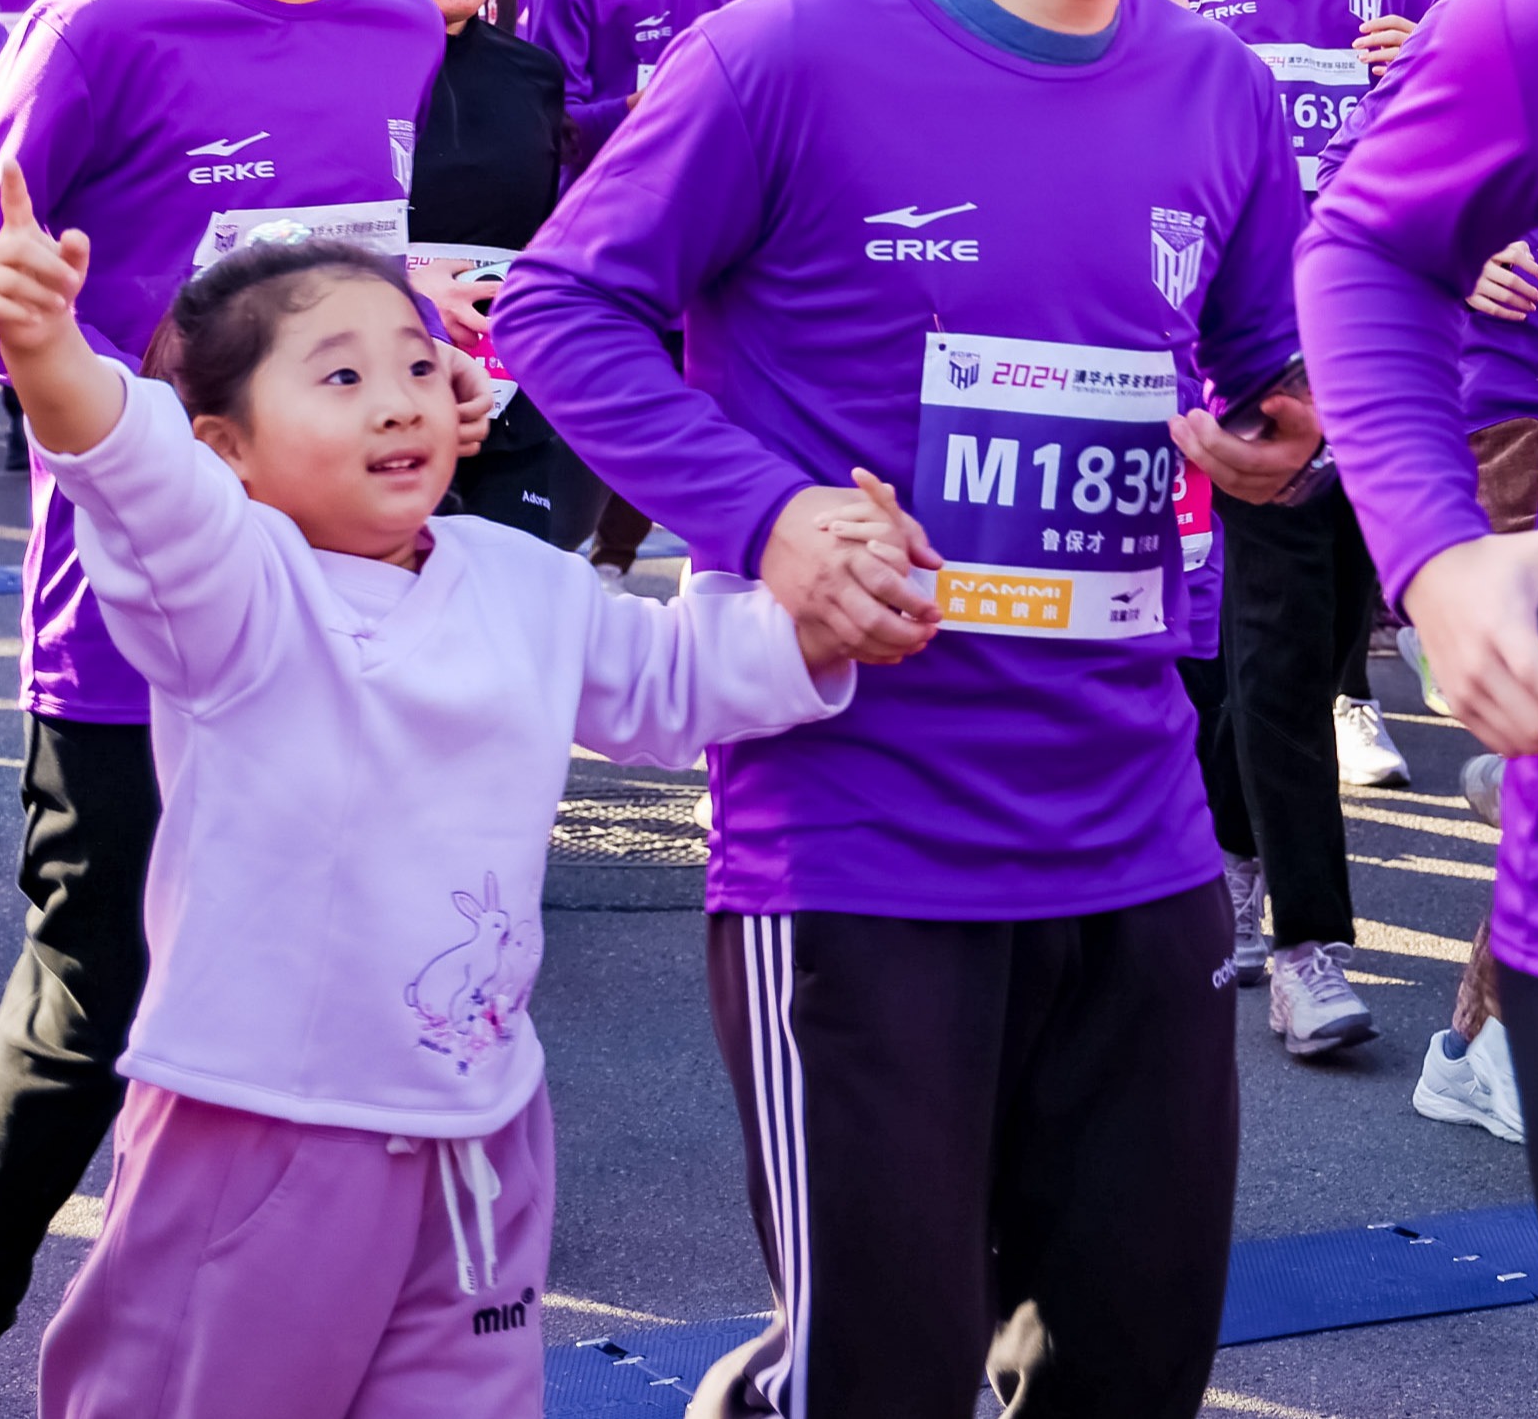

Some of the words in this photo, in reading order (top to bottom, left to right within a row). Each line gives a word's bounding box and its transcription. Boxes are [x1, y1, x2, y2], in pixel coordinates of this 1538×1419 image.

[1203, 1, 1257, 20] ERKE
[187, 160, 275, 184] ERKE
[1151, 206, 1207, 229] 2024
[864, 239, 980, 262] ERKE
[991, 361, 1069, 391] 2024
[942, 433, 1171, 517] M1839
[949, 579, 1061, 599] NAMMI
